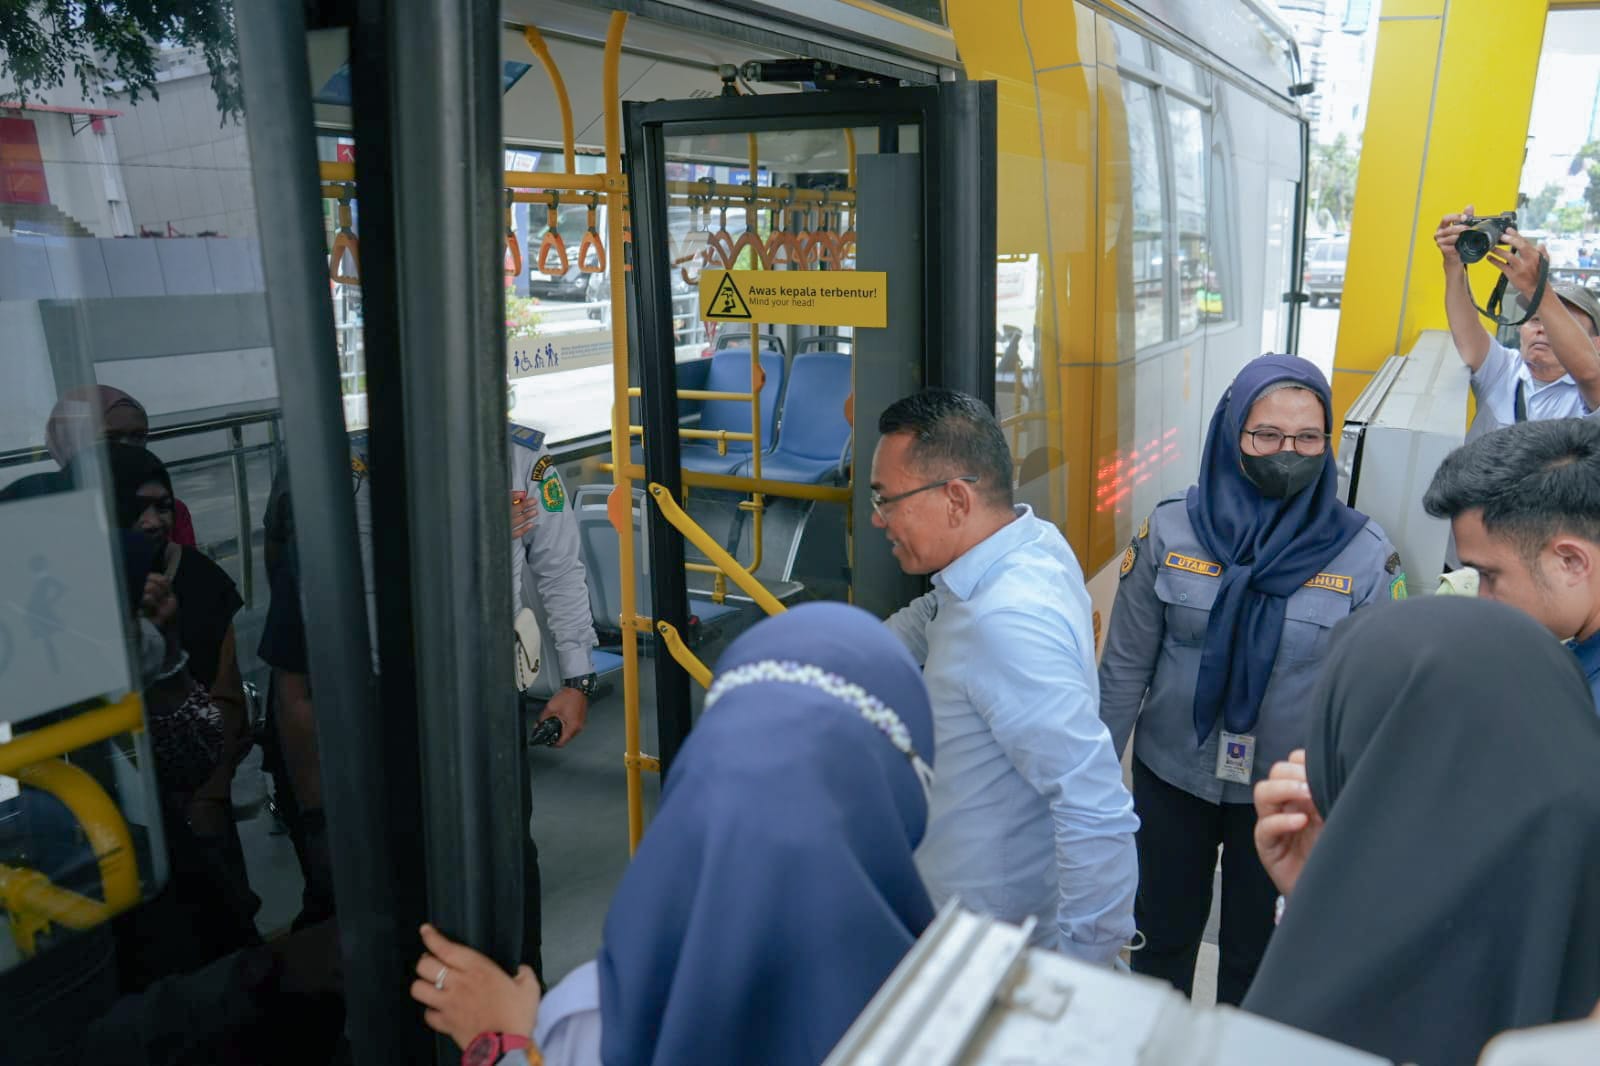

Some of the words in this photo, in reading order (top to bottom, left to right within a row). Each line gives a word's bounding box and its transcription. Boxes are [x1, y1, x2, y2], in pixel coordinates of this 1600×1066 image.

[748, 285, 777, 296] Awas
[780, 286, 817, 298] kepala
[820, 287, 878, 298] terbentur!
[748, 297, 770, 306] Mind
[771, 299, 790, 308] your
[792, 298, 815, 307] head!
[1178, 557, 1210, 573] UTAMI
